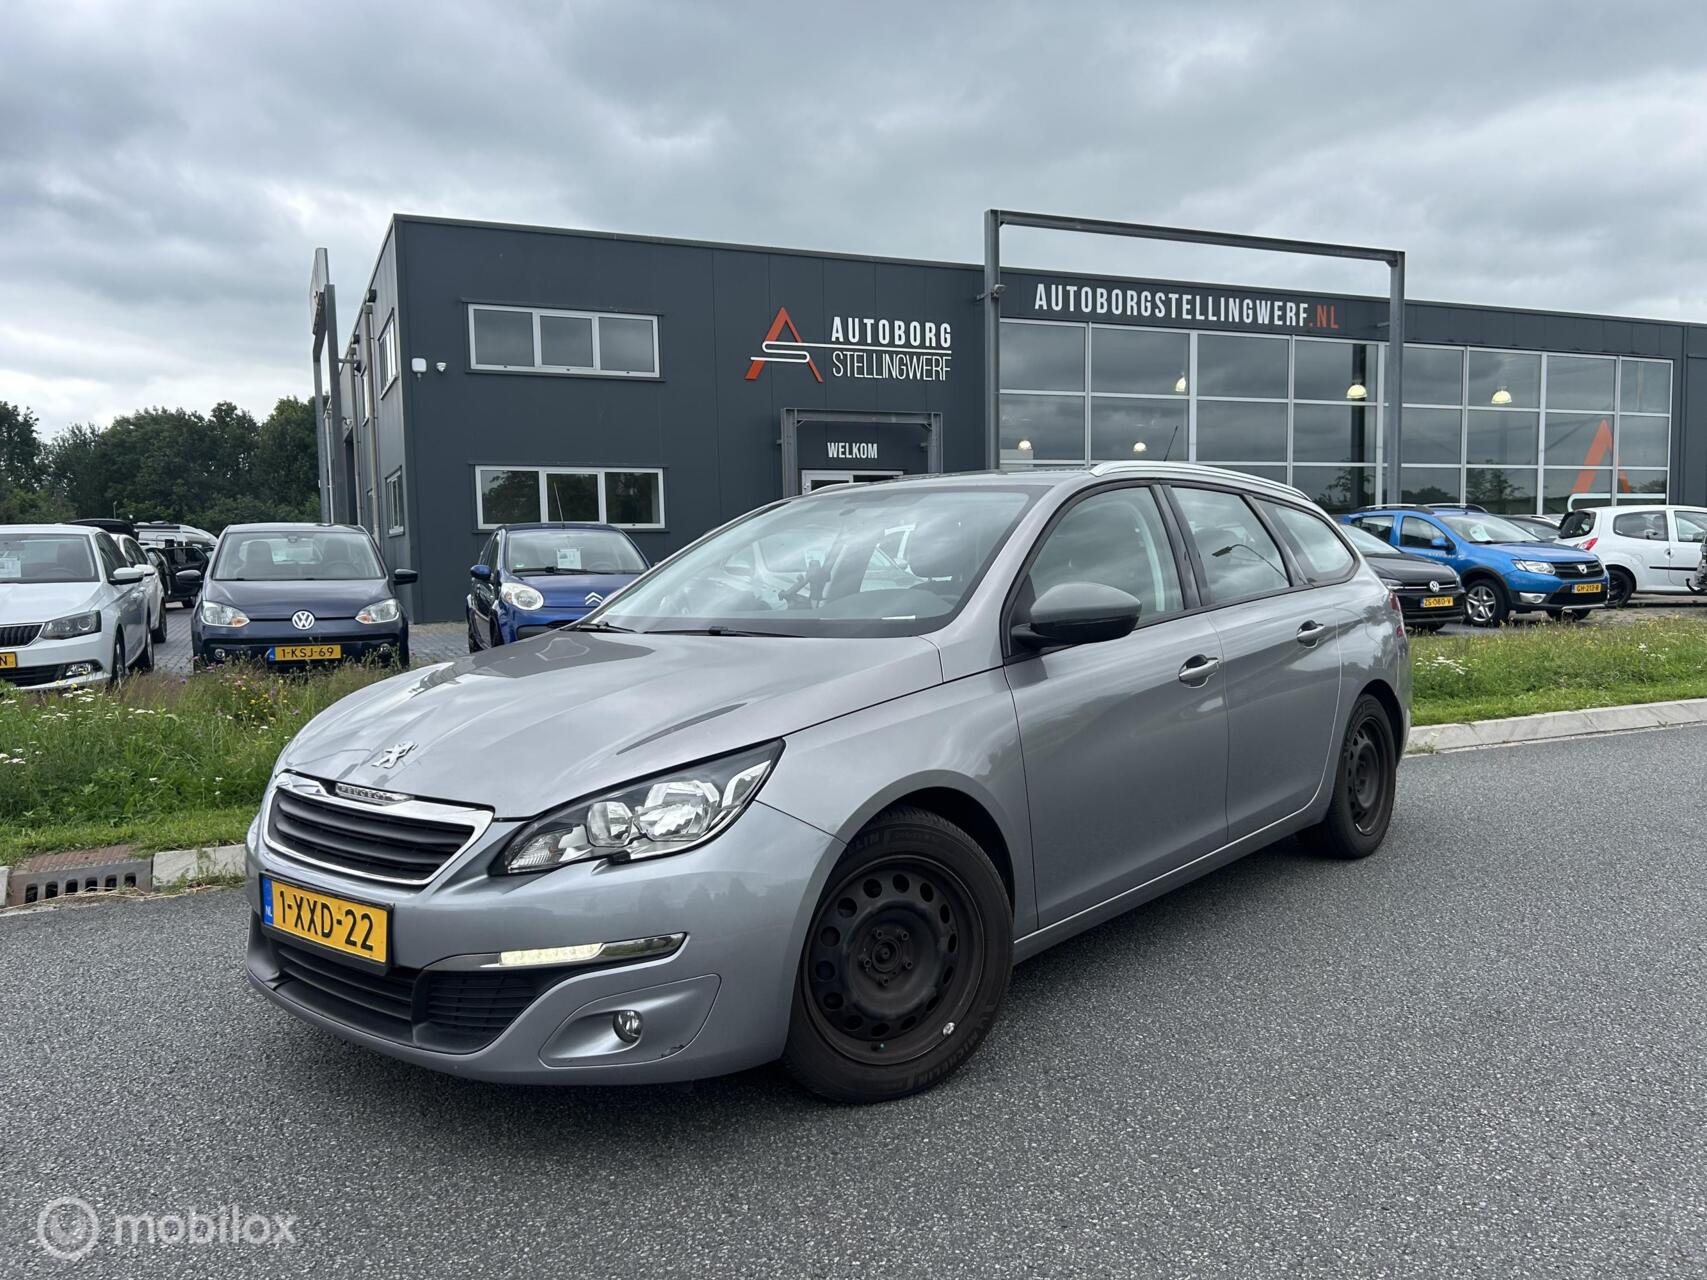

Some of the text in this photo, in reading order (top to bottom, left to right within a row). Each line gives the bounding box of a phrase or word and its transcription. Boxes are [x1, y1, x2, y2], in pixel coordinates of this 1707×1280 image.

[1034, 283, 1339, 329] AUTOBORGSTELLINGWERF.NL
[831, 316, 951, 348] AUTOBORG
[832, 351, 952, 381] STELLINGWERF
[827, 442, 878, 459] WELKOM
[281, 646, 335, 659] 1-KSJ-69
[279, 889, 375, 952] 1-XXD-22
